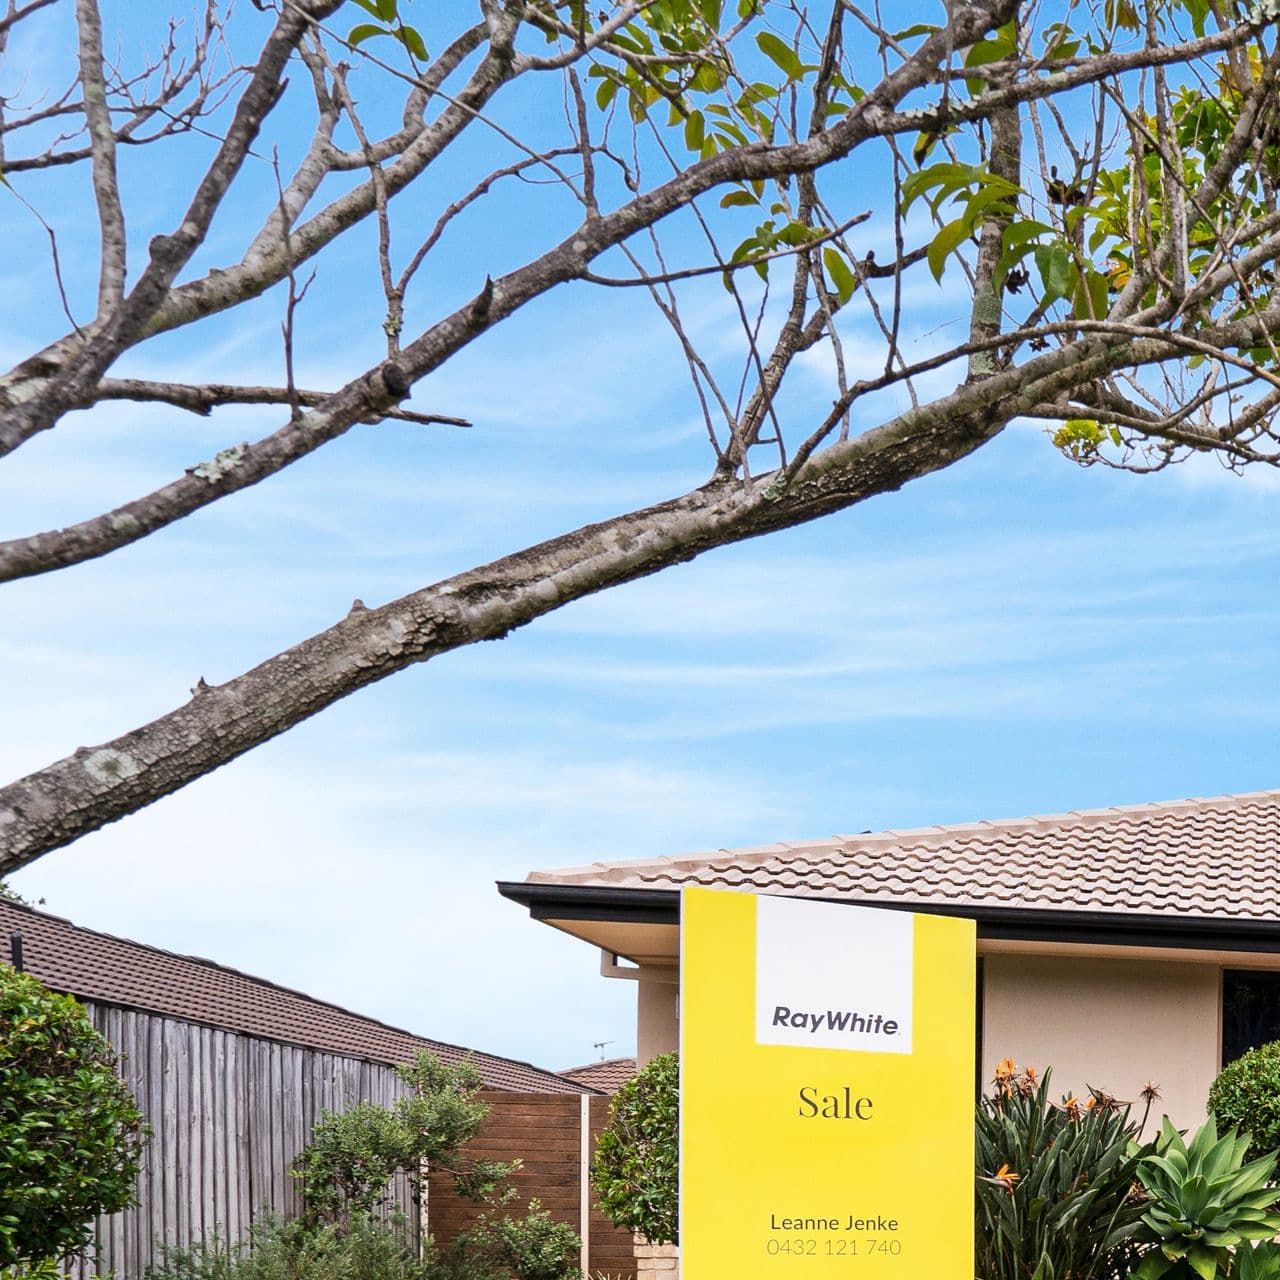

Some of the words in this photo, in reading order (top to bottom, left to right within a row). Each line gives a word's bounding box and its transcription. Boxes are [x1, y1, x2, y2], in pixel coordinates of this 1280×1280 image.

[799, 1086, 873, 1121] Sale
[771, 1214, 839, 1231] Leanne
[845, 1215, 898, 1231] Jenke
[766, 1238, 817, 1256] 0432
[824, 1239, 859, 1256] 121
[866, 1239, 902, 1256] 740
